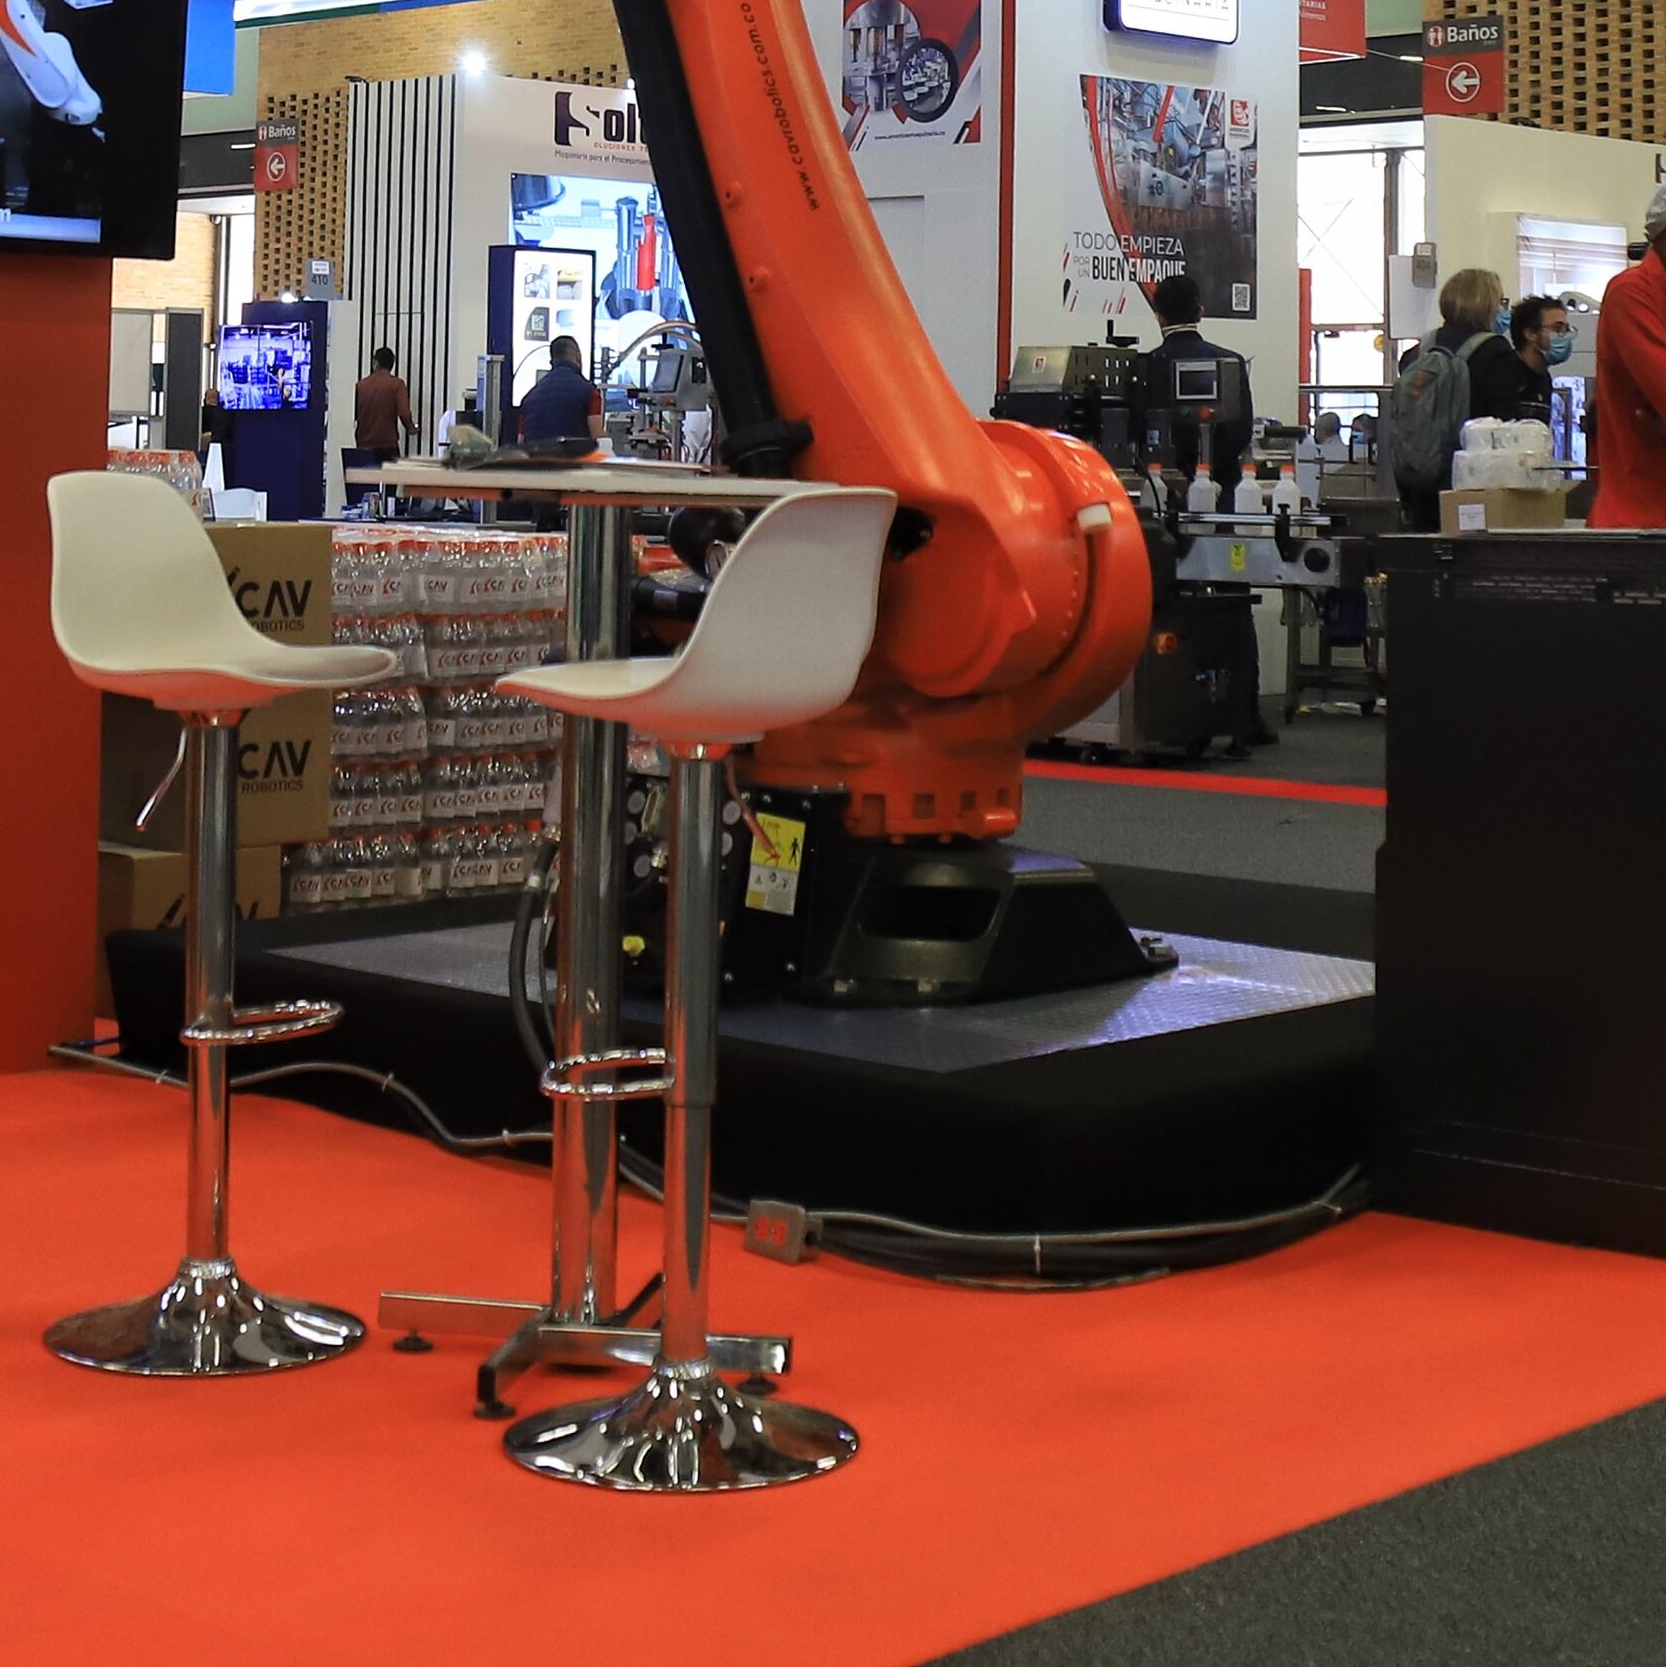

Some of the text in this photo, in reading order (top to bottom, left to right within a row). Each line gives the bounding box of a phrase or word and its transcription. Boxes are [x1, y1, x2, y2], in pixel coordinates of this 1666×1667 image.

[1447, 24, 1498, 42] Baños
[740, 2, 820, 212] www.cavrobotics.com.co
[268, 124, 296, 138] Baños
[1073, 232, 1184, 256] TODO EMPIEZA
[1092, 256, 1124, 282] BUEN
[311, 275, 328, 286] 410
[235, 580, 312, 621] CAV
[251, 618, 305, 634] OBOTICS
[238, 740, 311, 780] CAV
[241, 779, 303, 795] ROBOTICS
